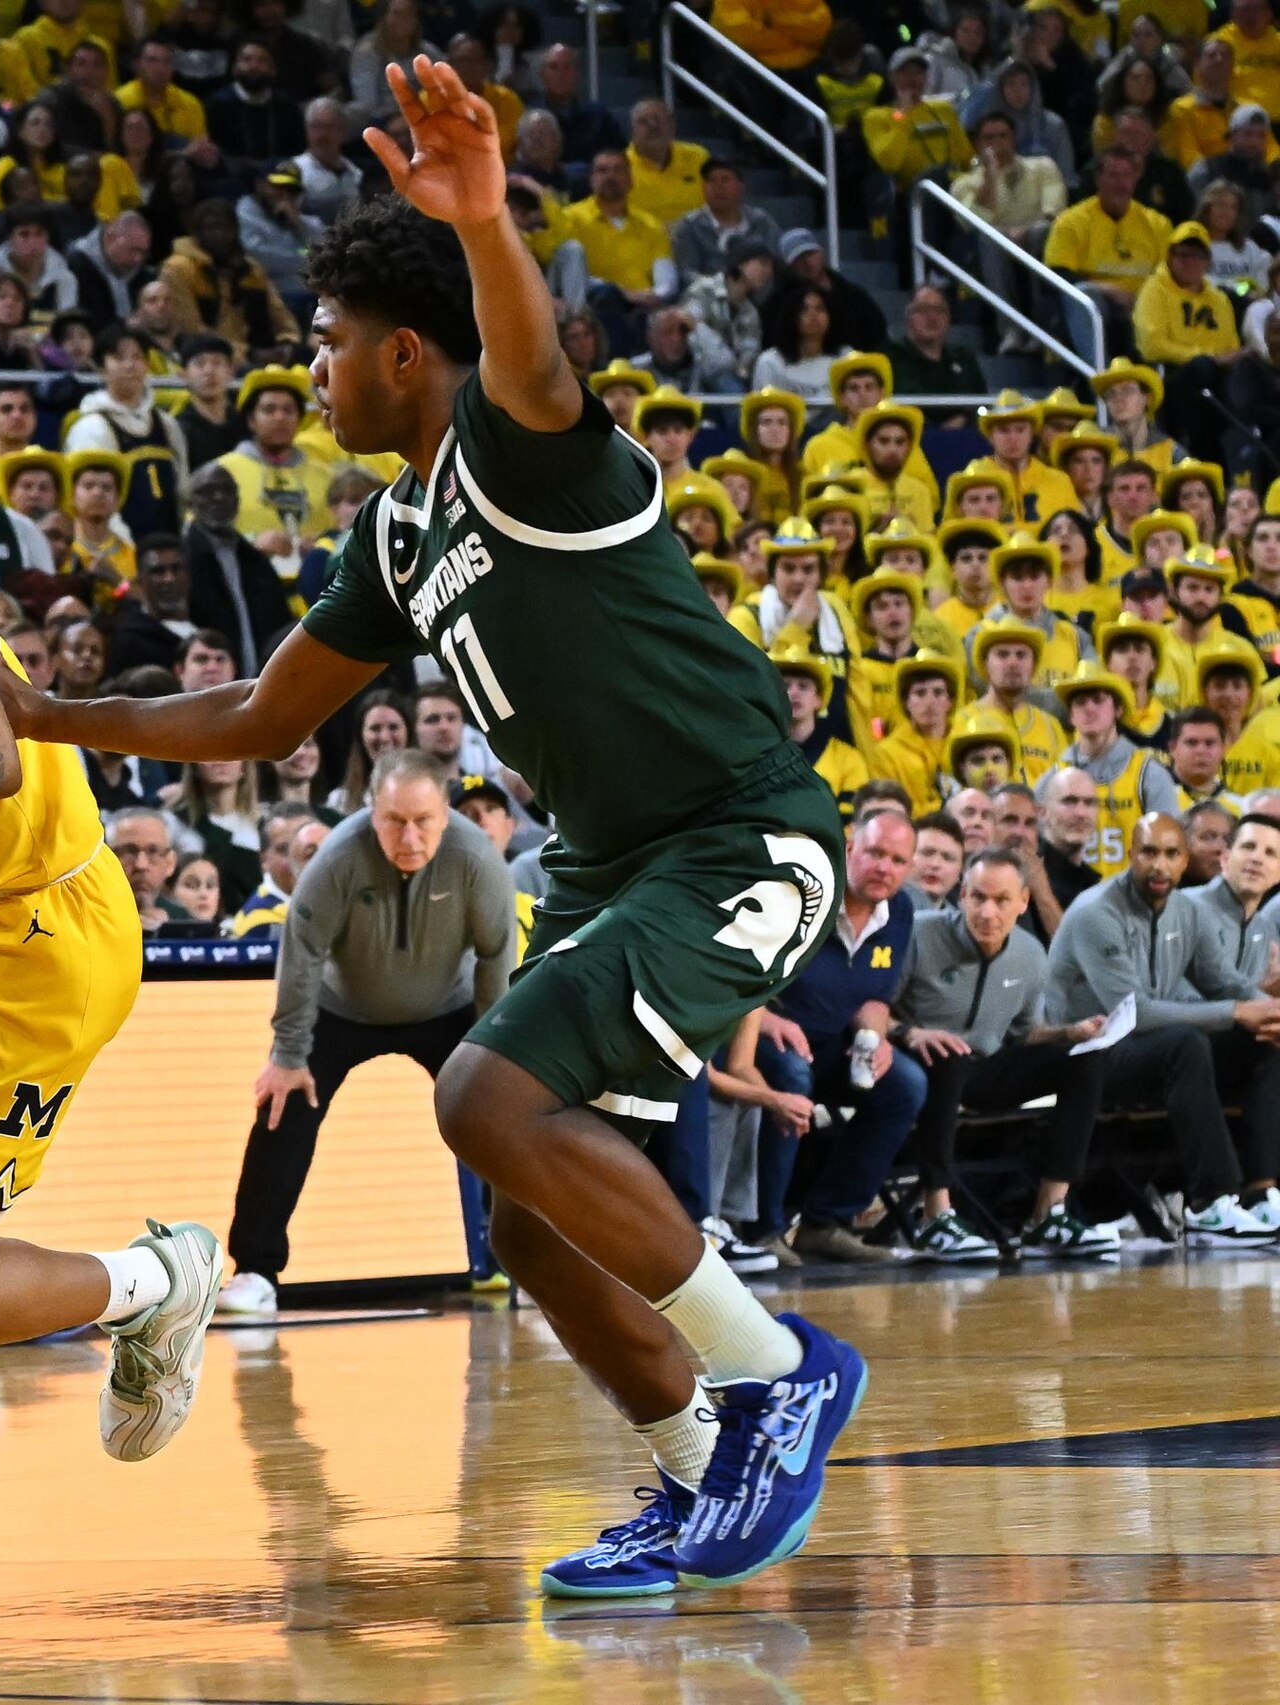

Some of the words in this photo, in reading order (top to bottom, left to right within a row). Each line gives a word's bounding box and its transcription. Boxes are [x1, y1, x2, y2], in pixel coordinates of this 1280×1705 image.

[408, 531, 494, 640] SPARTANS
[440, 612, 516, 733] 11
[870, 945, 892, 969] M
